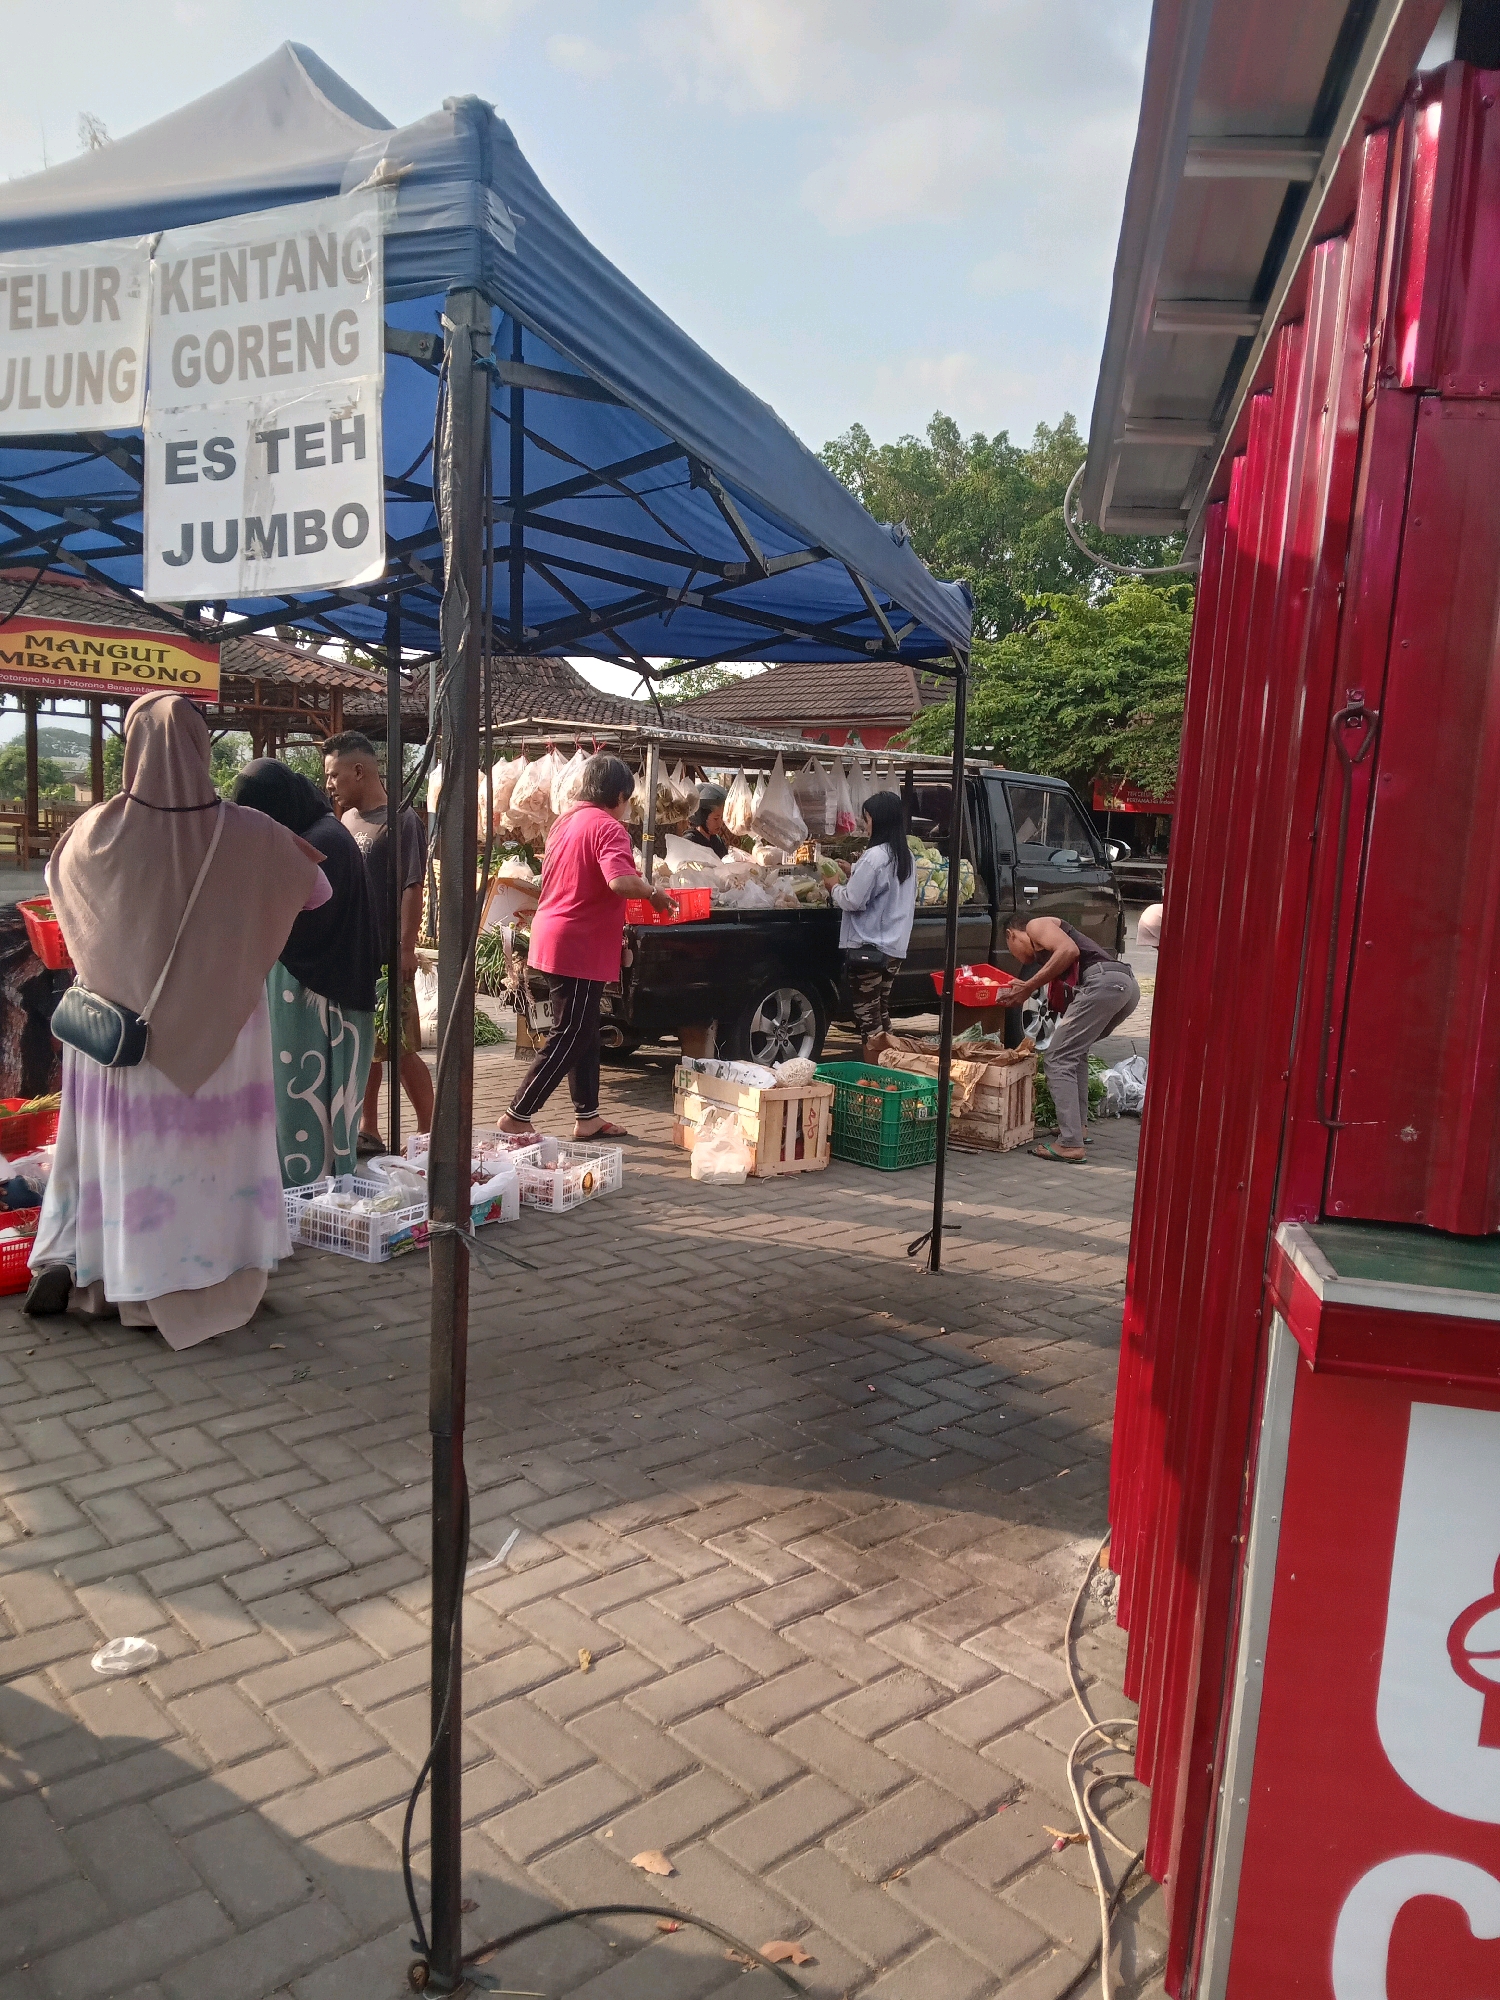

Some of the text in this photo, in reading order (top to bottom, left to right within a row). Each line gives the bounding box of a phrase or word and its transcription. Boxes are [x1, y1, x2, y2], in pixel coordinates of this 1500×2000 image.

[0, 265, 121, 331] ELUR
[160, 226, 372, 316] KENTANG
[172, 309, 361, 389] GORENG
[165, 413, 367, 485] ES TEH
[162, 502, 370, 567] JUMBO
[0, 649, 201, 684] MBAH PONO
[25, 634, 171, 663] MANGUT
[63, 679, 105, 689] Potorono
